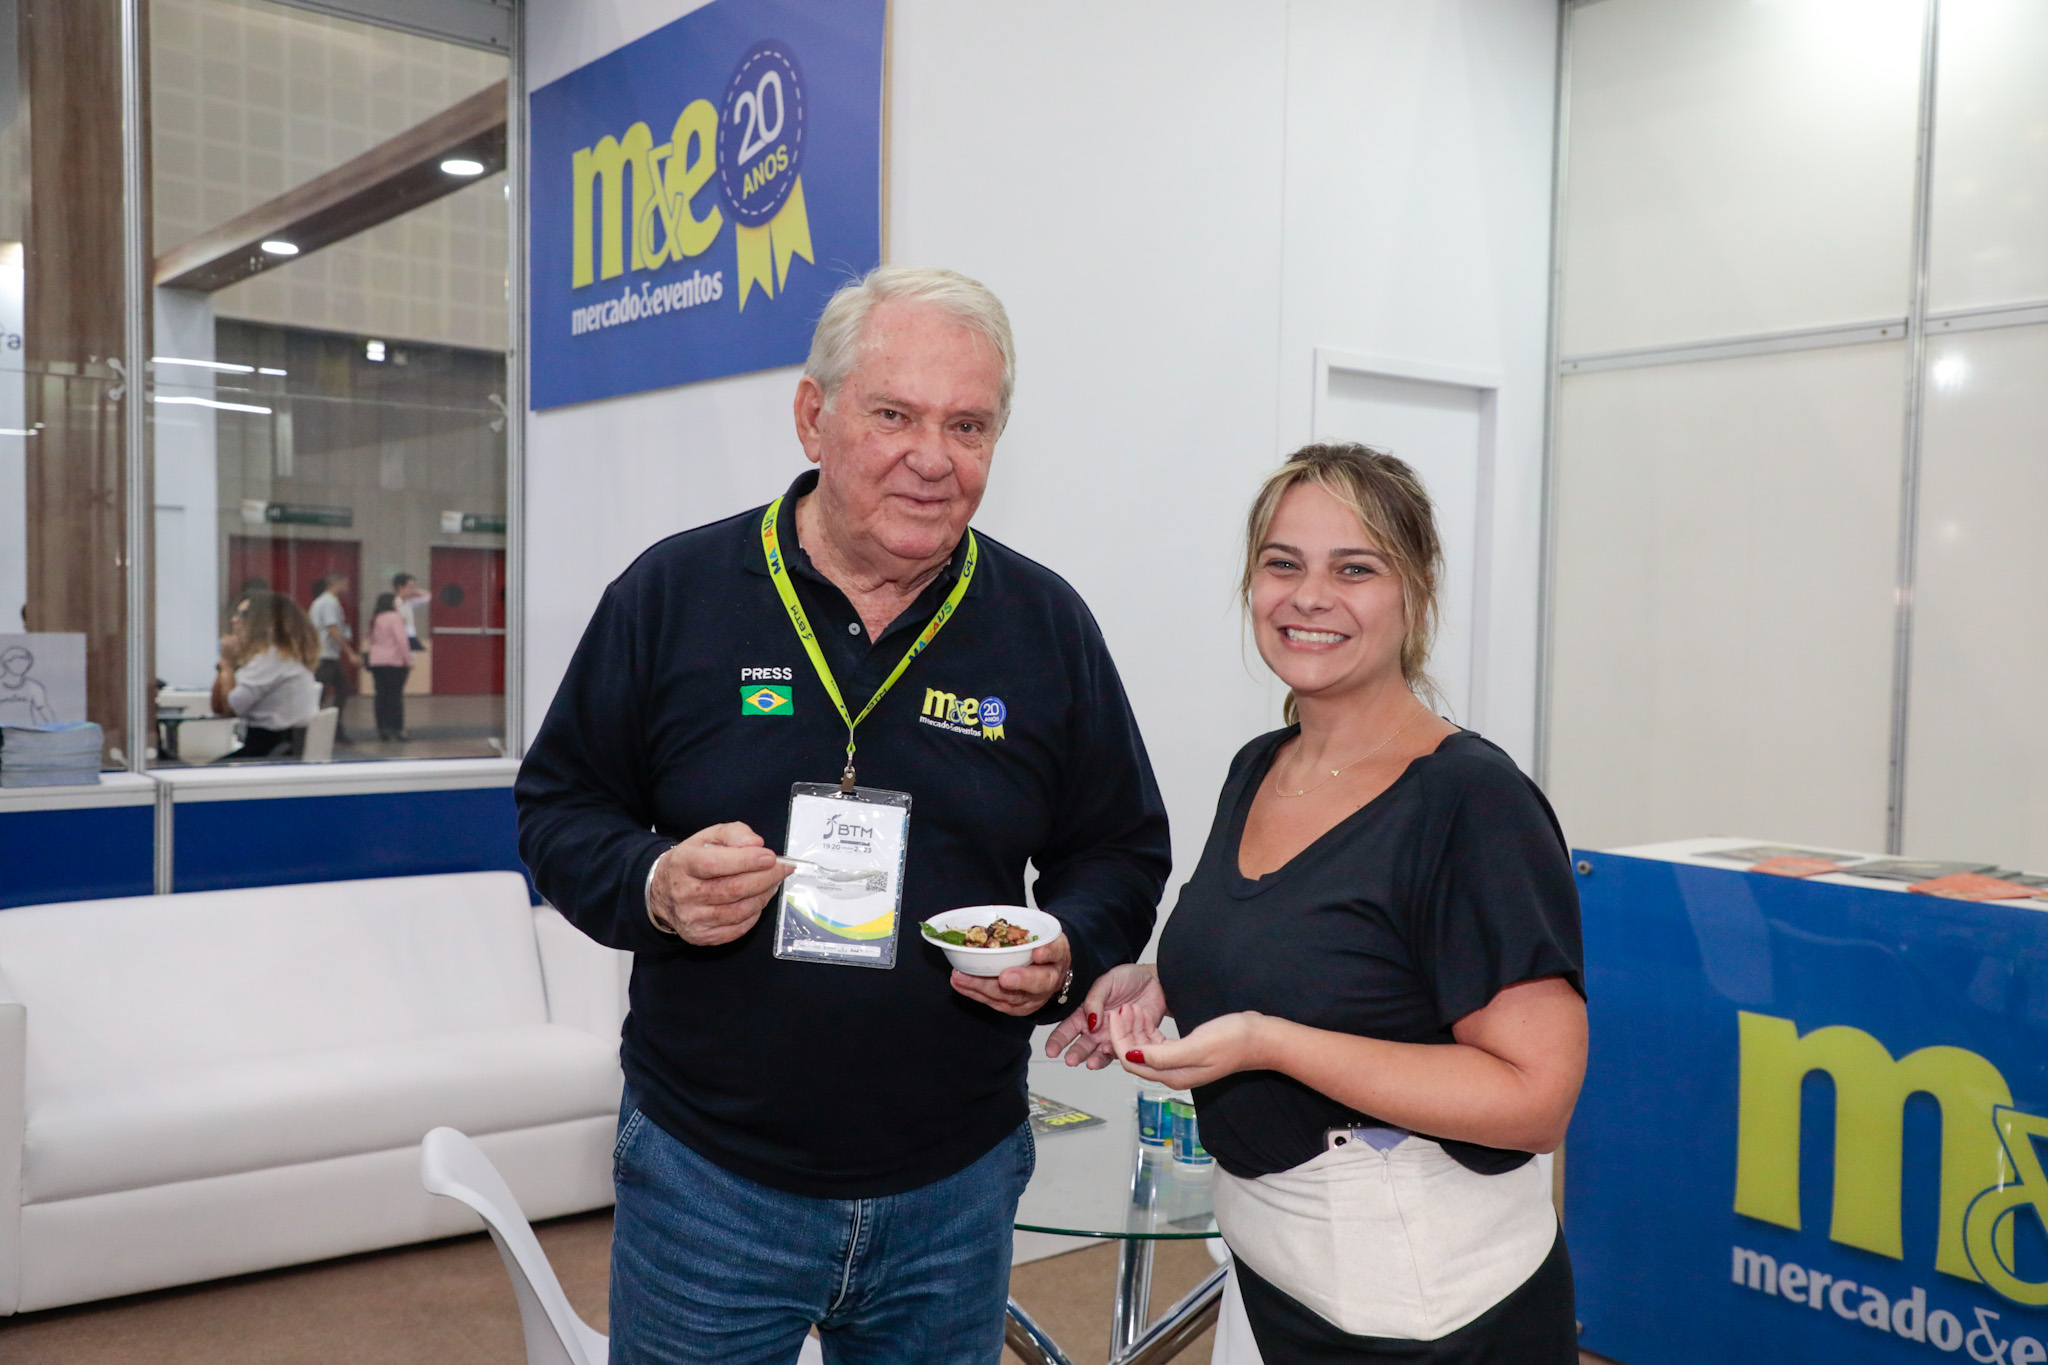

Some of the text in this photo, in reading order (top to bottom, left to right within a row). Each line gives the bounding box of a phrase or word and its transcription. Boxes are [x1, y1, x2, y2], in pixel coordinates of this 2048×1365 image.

[734, 70, 784, 166] 20
[572, 98, 723, 289] m&e
[743, 144, 788, 200] ANOS
[572, 270, 723, 336] mercado&eventos
[908, 600, 952, 662] MANAUS
[741, 667, 793, 681] PRESS
[922, 687, 979, 726] m&e
[983, 702, 1000, 717] 20
[837, 823, 873, 839] BTM
[854, 846, 872, 854] 223
[1732, 1245, 2048, 1365] mercado&e
